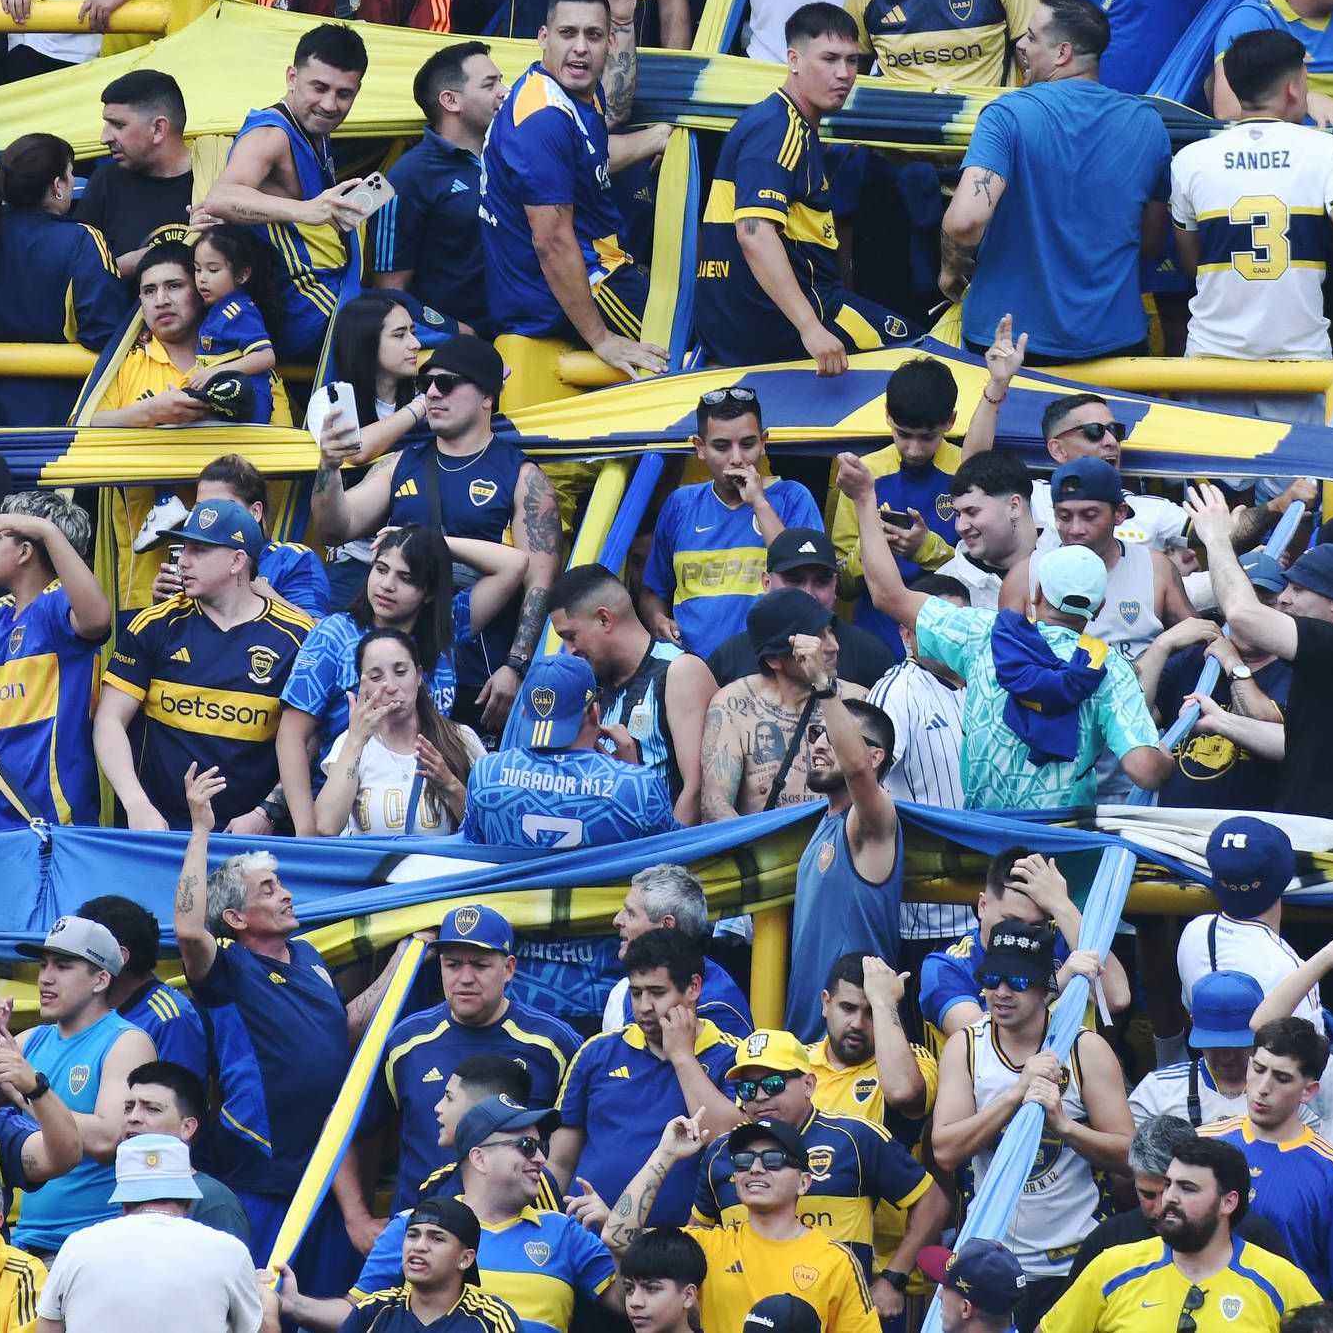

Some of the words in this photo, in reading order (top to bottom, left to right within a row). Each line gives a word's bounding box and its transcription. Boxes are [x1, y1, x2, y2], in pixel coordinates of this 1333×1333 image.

[885, 41, 983, 69] betsson
[1224, 150, 1291, 170] SANDEZ
[758, 189, 788, 203] CETRO
[1230, 196, 1290, 280] 3
[471, 486, 493, 497] CABJ
[682, 562, 766, 587] PEPS
[113, 652, 137, 666] TROGAR
[161, 689, 270, 729] betsson
[534, 697, 554, 705] CABJ
[499, 765, 576, 795] JUGADOR
[810, 1157, 829, 1165] CABJ
